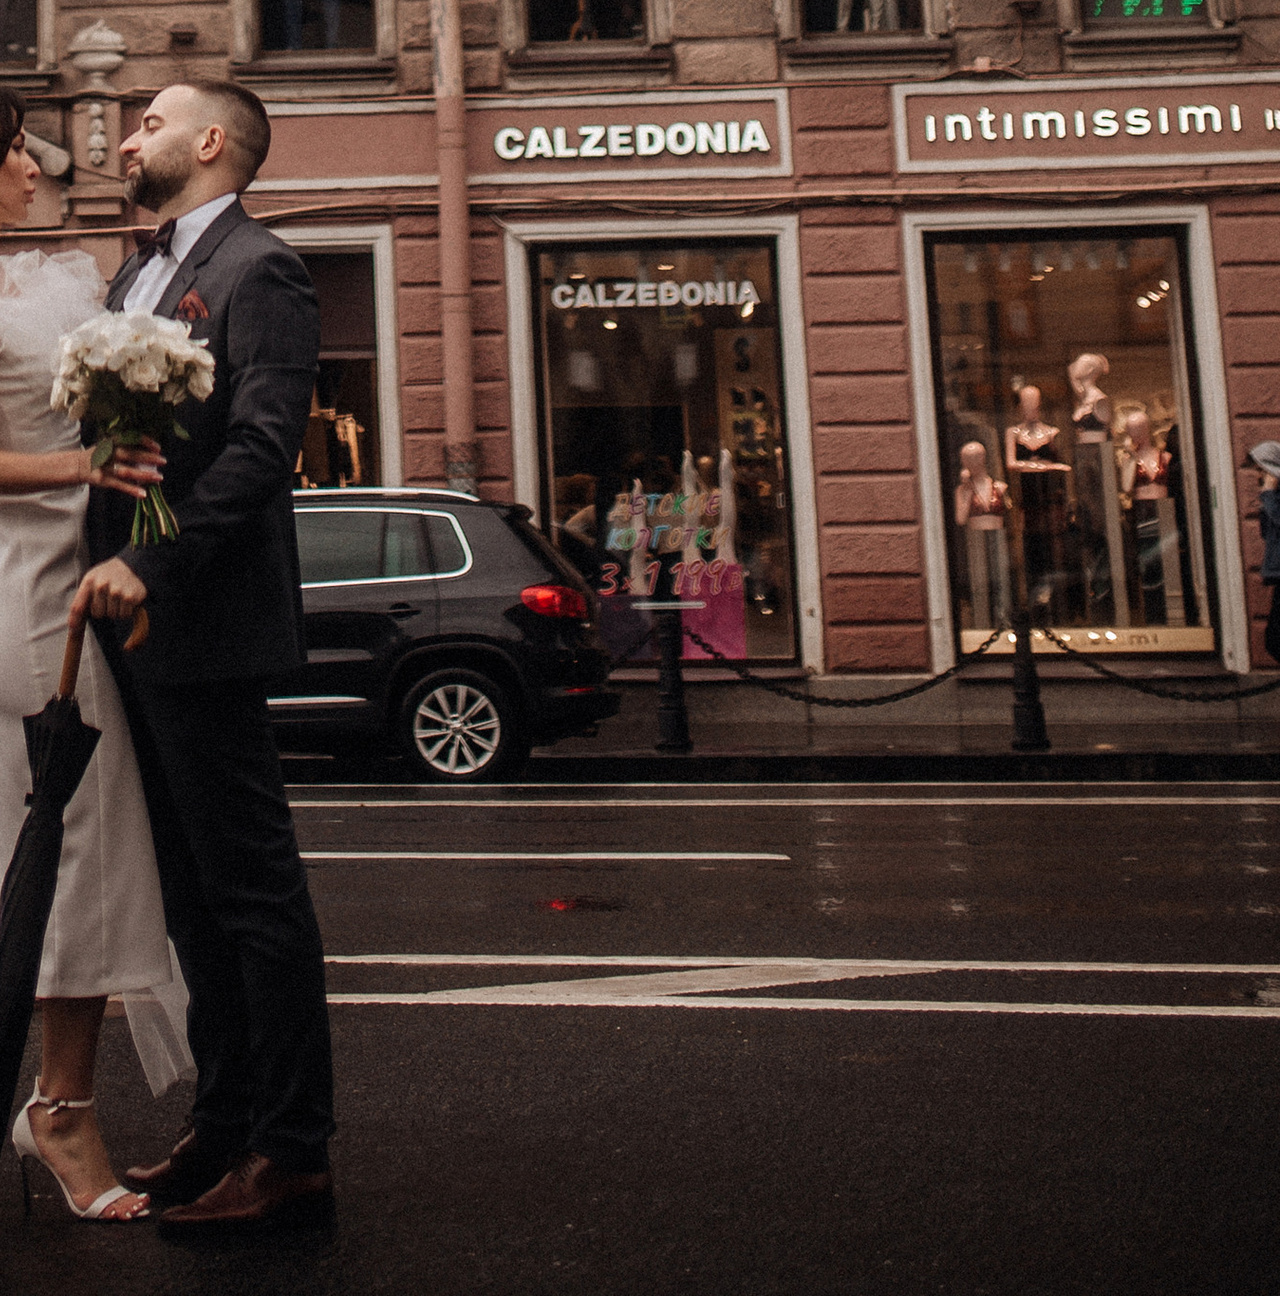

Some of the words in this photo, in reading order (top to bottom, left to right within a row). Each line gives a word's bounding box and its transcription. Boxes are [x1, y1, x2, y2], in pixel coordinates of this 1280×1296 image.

[925, 104, 1242, 142] intimissimi
[493, 119, 771, 160] CALZEDONIA
[551, 280, 761, 309] CALZEDONIA
[607, 492, 721, 522] ДЕТСКИЕ
[605, 524, 731, 550] КОЛГОТКИ
